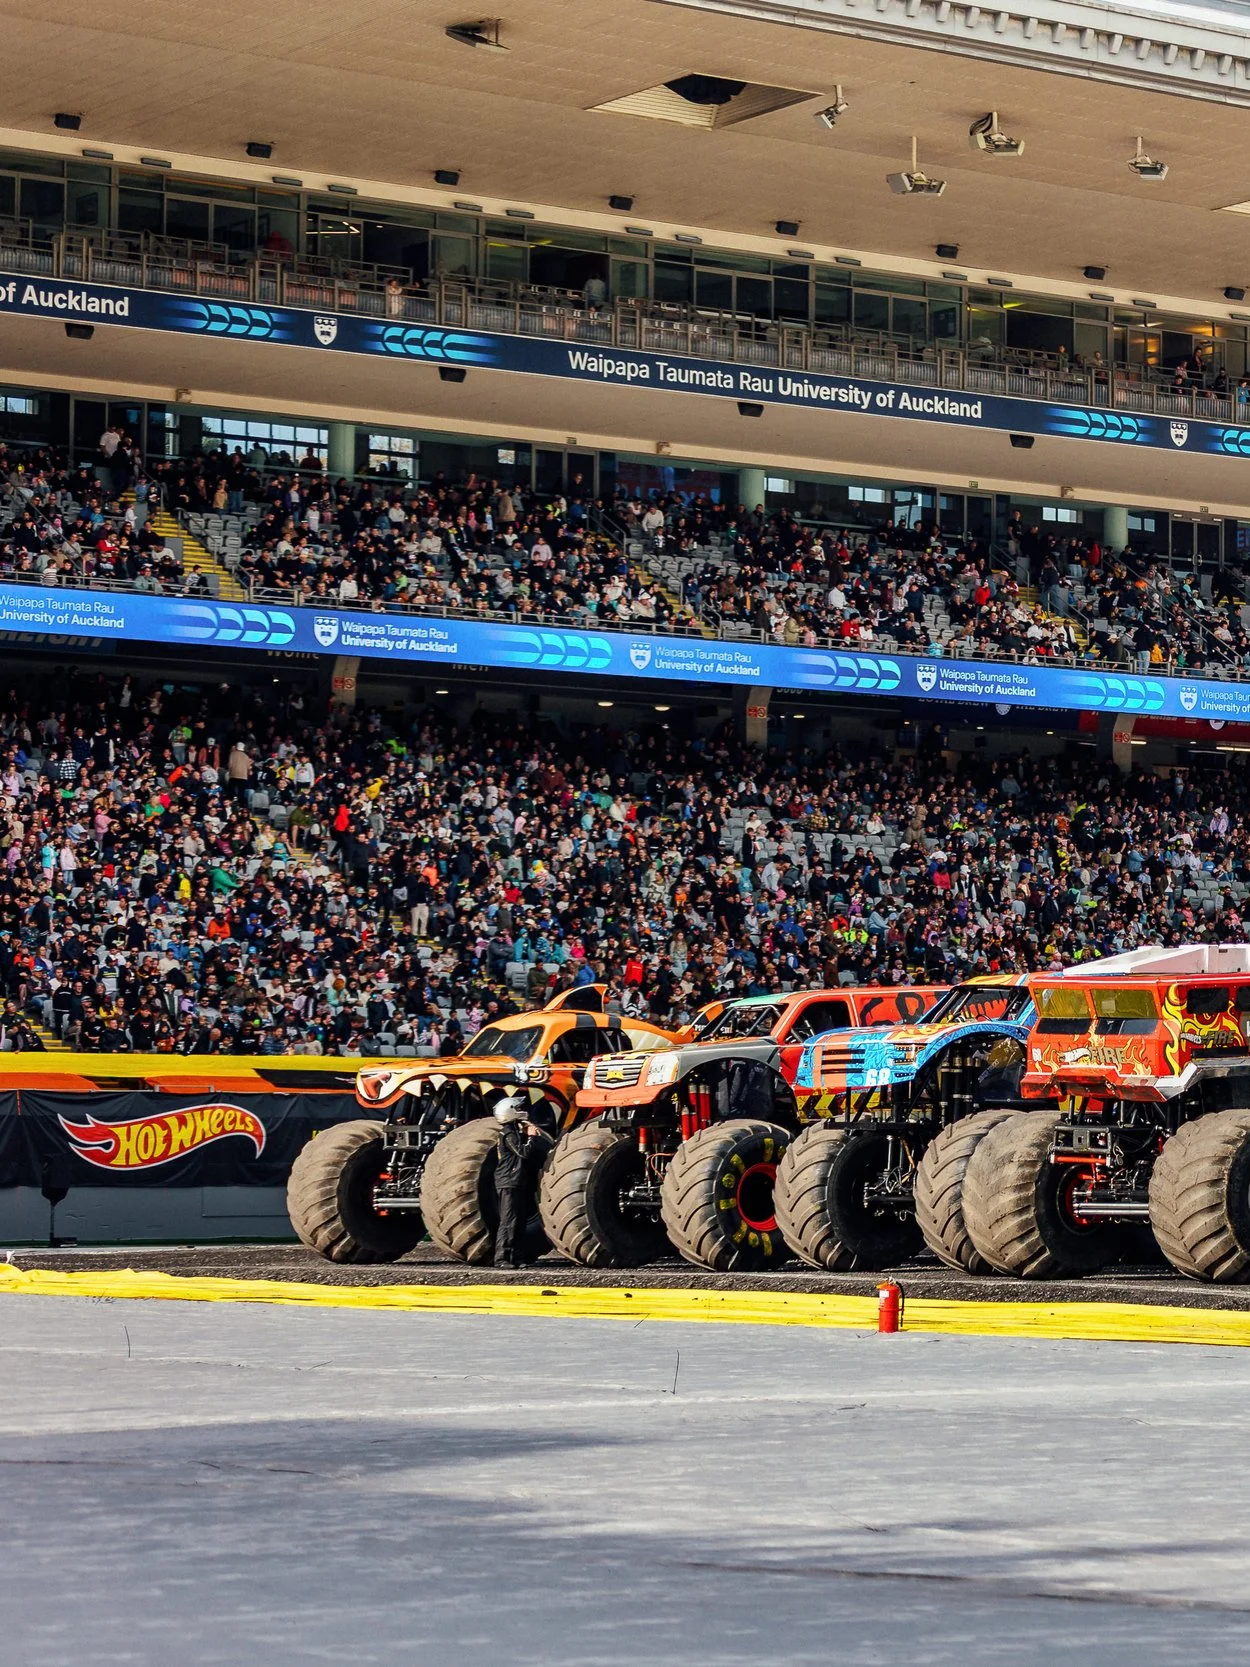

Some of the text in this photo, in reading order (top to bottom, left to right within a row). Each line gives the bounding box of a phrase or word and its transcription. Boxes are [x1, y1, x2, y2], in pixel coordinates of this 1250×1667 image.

[21, 284, 130, 317] Auckland
[567, 350, 982, 419] Waipapa Taumata Rau University of Auckland
[0, 595, 115, 614] Waipapa Taumata Rau
[0, 608, 125, 629] University of Auckland
[341, 621, 449, 639] Waipapa Taumata Rau
[341, 634, 458, 653] University of Auckland
[655, 645, 752, 663] Waipapa Taumata Rau
[655, 659, 760, 677] University of Auckland
[940, 668, 1029, 685] Waipapa Taumata Rau
[939, 680, 1036, 697] University of Auckland
[1200, 689, 1234, 701] Waipapa
[1200, 700, 1241, 714] University
[1241, 704, 1250, 713] of
[1206, 1030, 1236, 1045] FIRE
[1090, 1046, 1126, 1064] FIRE
[107, 1122, 168, 1166] HOT
